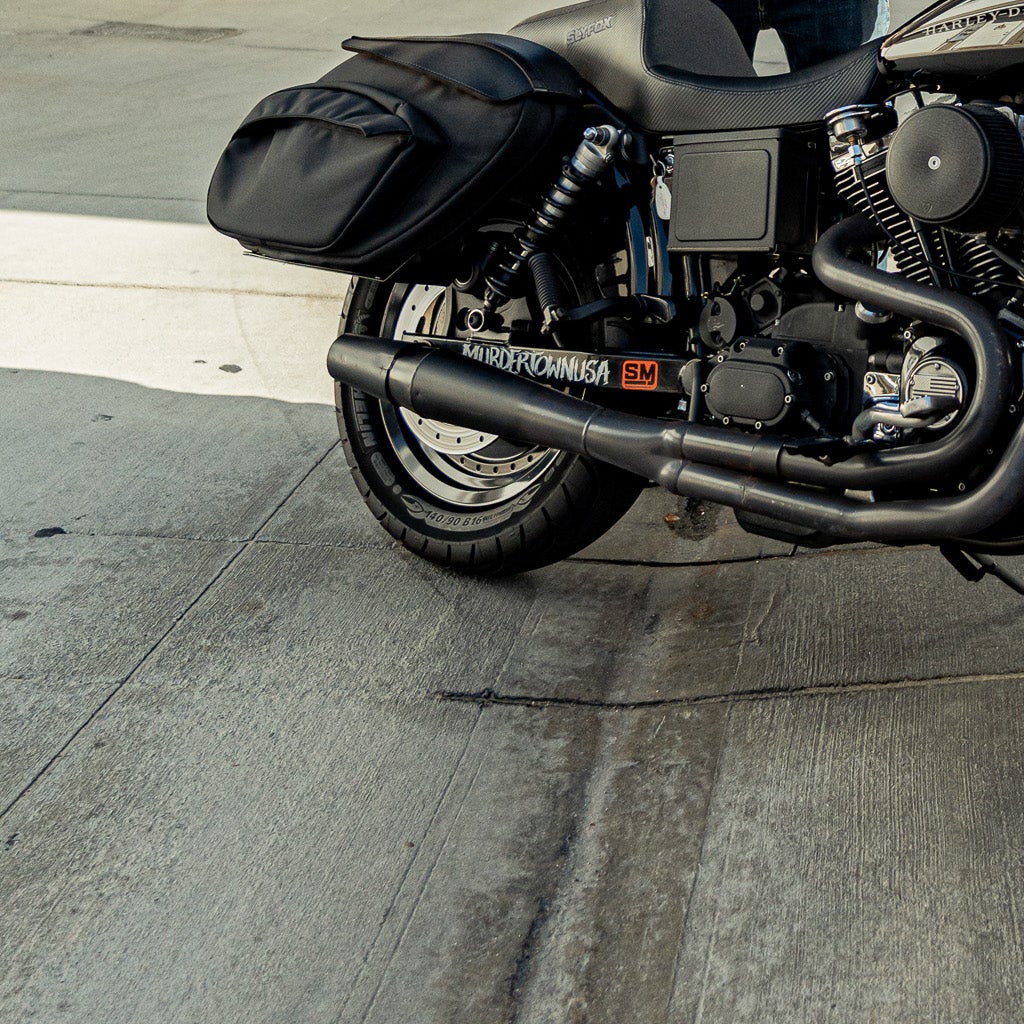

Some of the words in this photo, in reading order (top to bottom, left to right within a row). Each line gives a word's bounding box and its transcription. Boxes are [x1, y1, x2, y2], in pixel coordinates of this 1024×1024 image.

[566, 16, 614, 45] SLYFOX
[462, 343, 610, 386] MURDERTOWNUSA
[624, 362, 656, 384] SM
[425, 510, 461, 526] 140/90
[462, 515, 483, 527] B16
